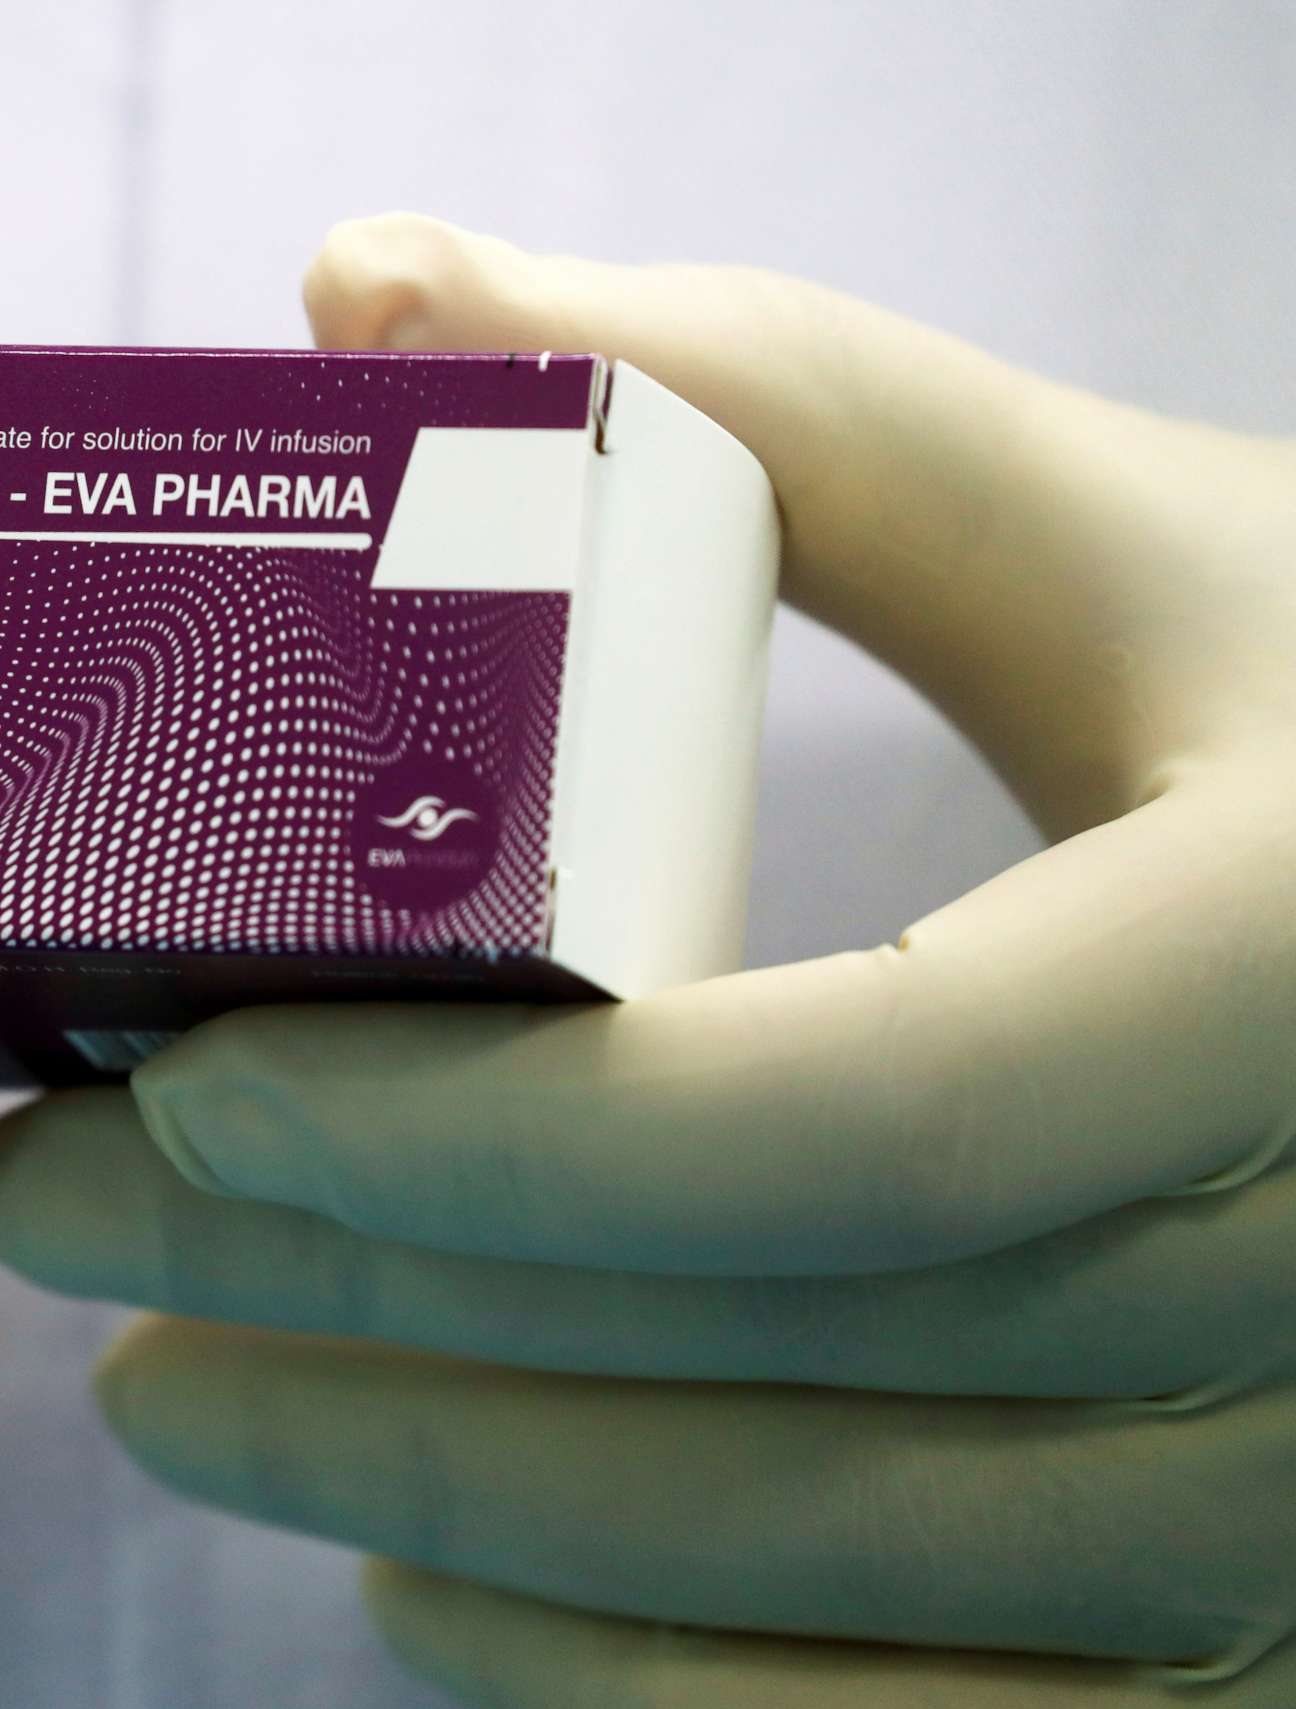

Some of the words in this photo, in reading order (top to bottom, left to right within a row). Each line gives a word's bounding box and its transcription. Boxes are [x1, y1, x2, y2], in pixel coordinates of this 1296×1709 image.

[40, 426, 76, 450] for
[82, 427, 183, 452] solution
[192, 428, 227, 452] for
[235, 429, 263, 452] IV
[270, 429, 372, 455] infusion
[9, 492, 27, 502] -
[43, 471, 137, 517] EVA
[152, 473, 371, 521] PHARMA
[367, 848, 406, 867] EVA
